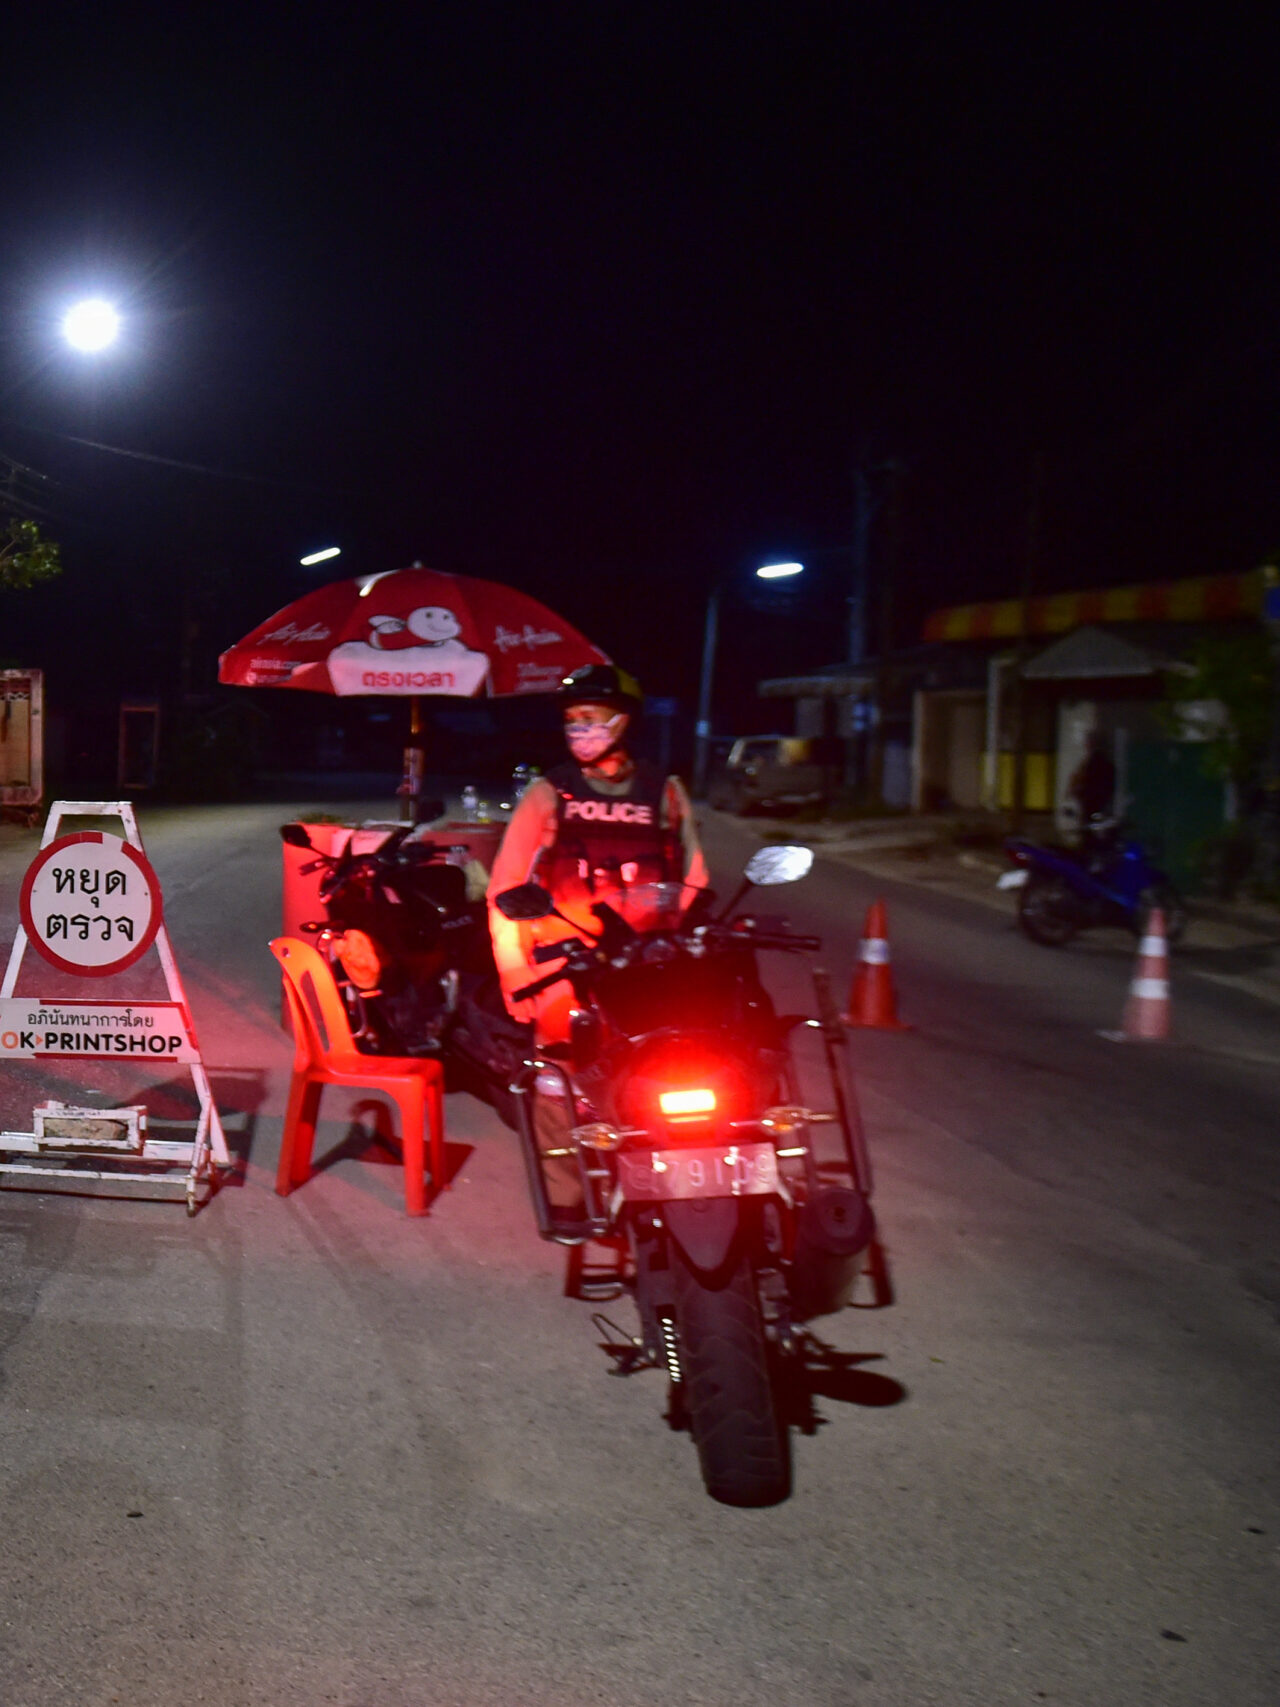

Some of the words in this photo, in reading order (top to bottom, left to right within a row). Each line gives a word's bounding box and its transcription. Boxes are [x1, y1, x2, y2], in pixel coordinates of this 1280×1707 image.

[564, 800, 653, 824] POLICE
[52, 867, 127, 908] หยุด
[45, 913, 134, 942] ตรวจ
[27, 1008, 155, 1029] อภินันทนาการโดย
